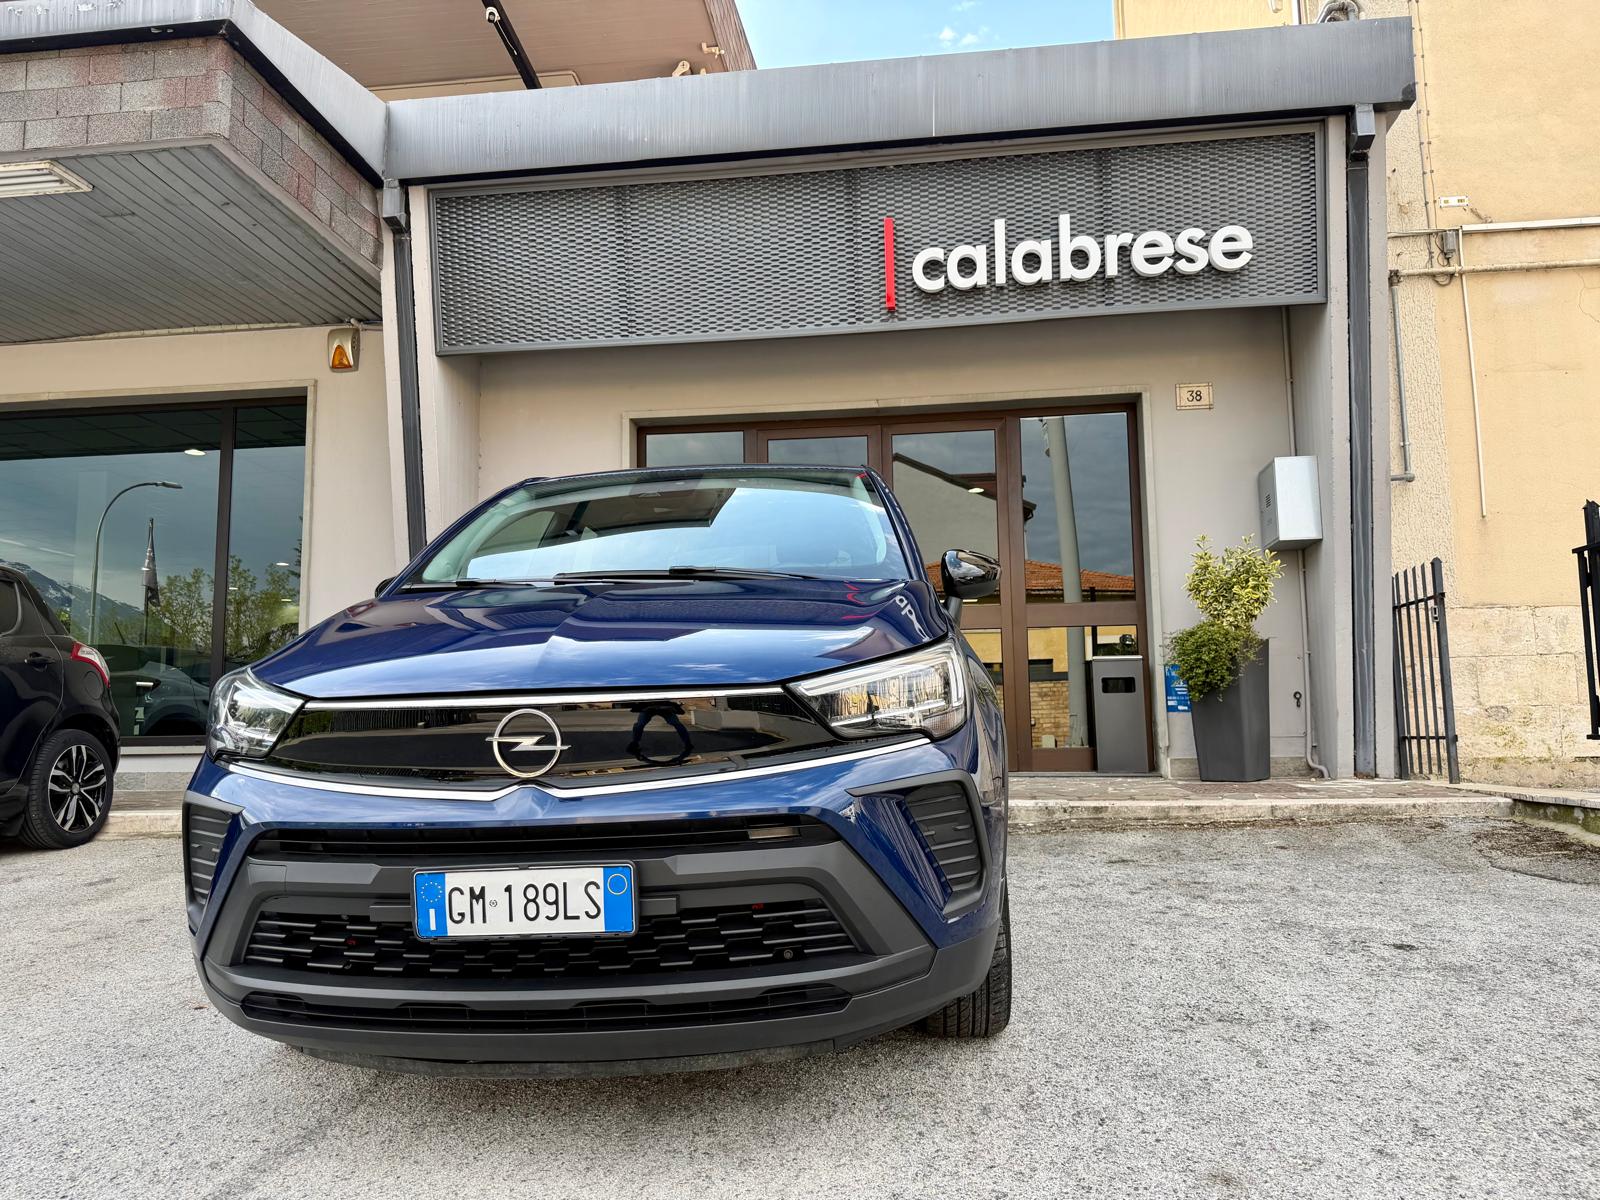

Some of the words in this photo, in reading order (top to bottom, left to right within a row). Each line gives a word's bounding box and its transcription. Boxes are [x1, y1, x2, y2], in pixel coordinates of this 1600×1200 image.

[911, 213, 1254, 294] calabrese
[1186, 389, 1203, 403] 38
[447, 885, 487, 925] GM
[503, 880, 602, 923] 189LS
